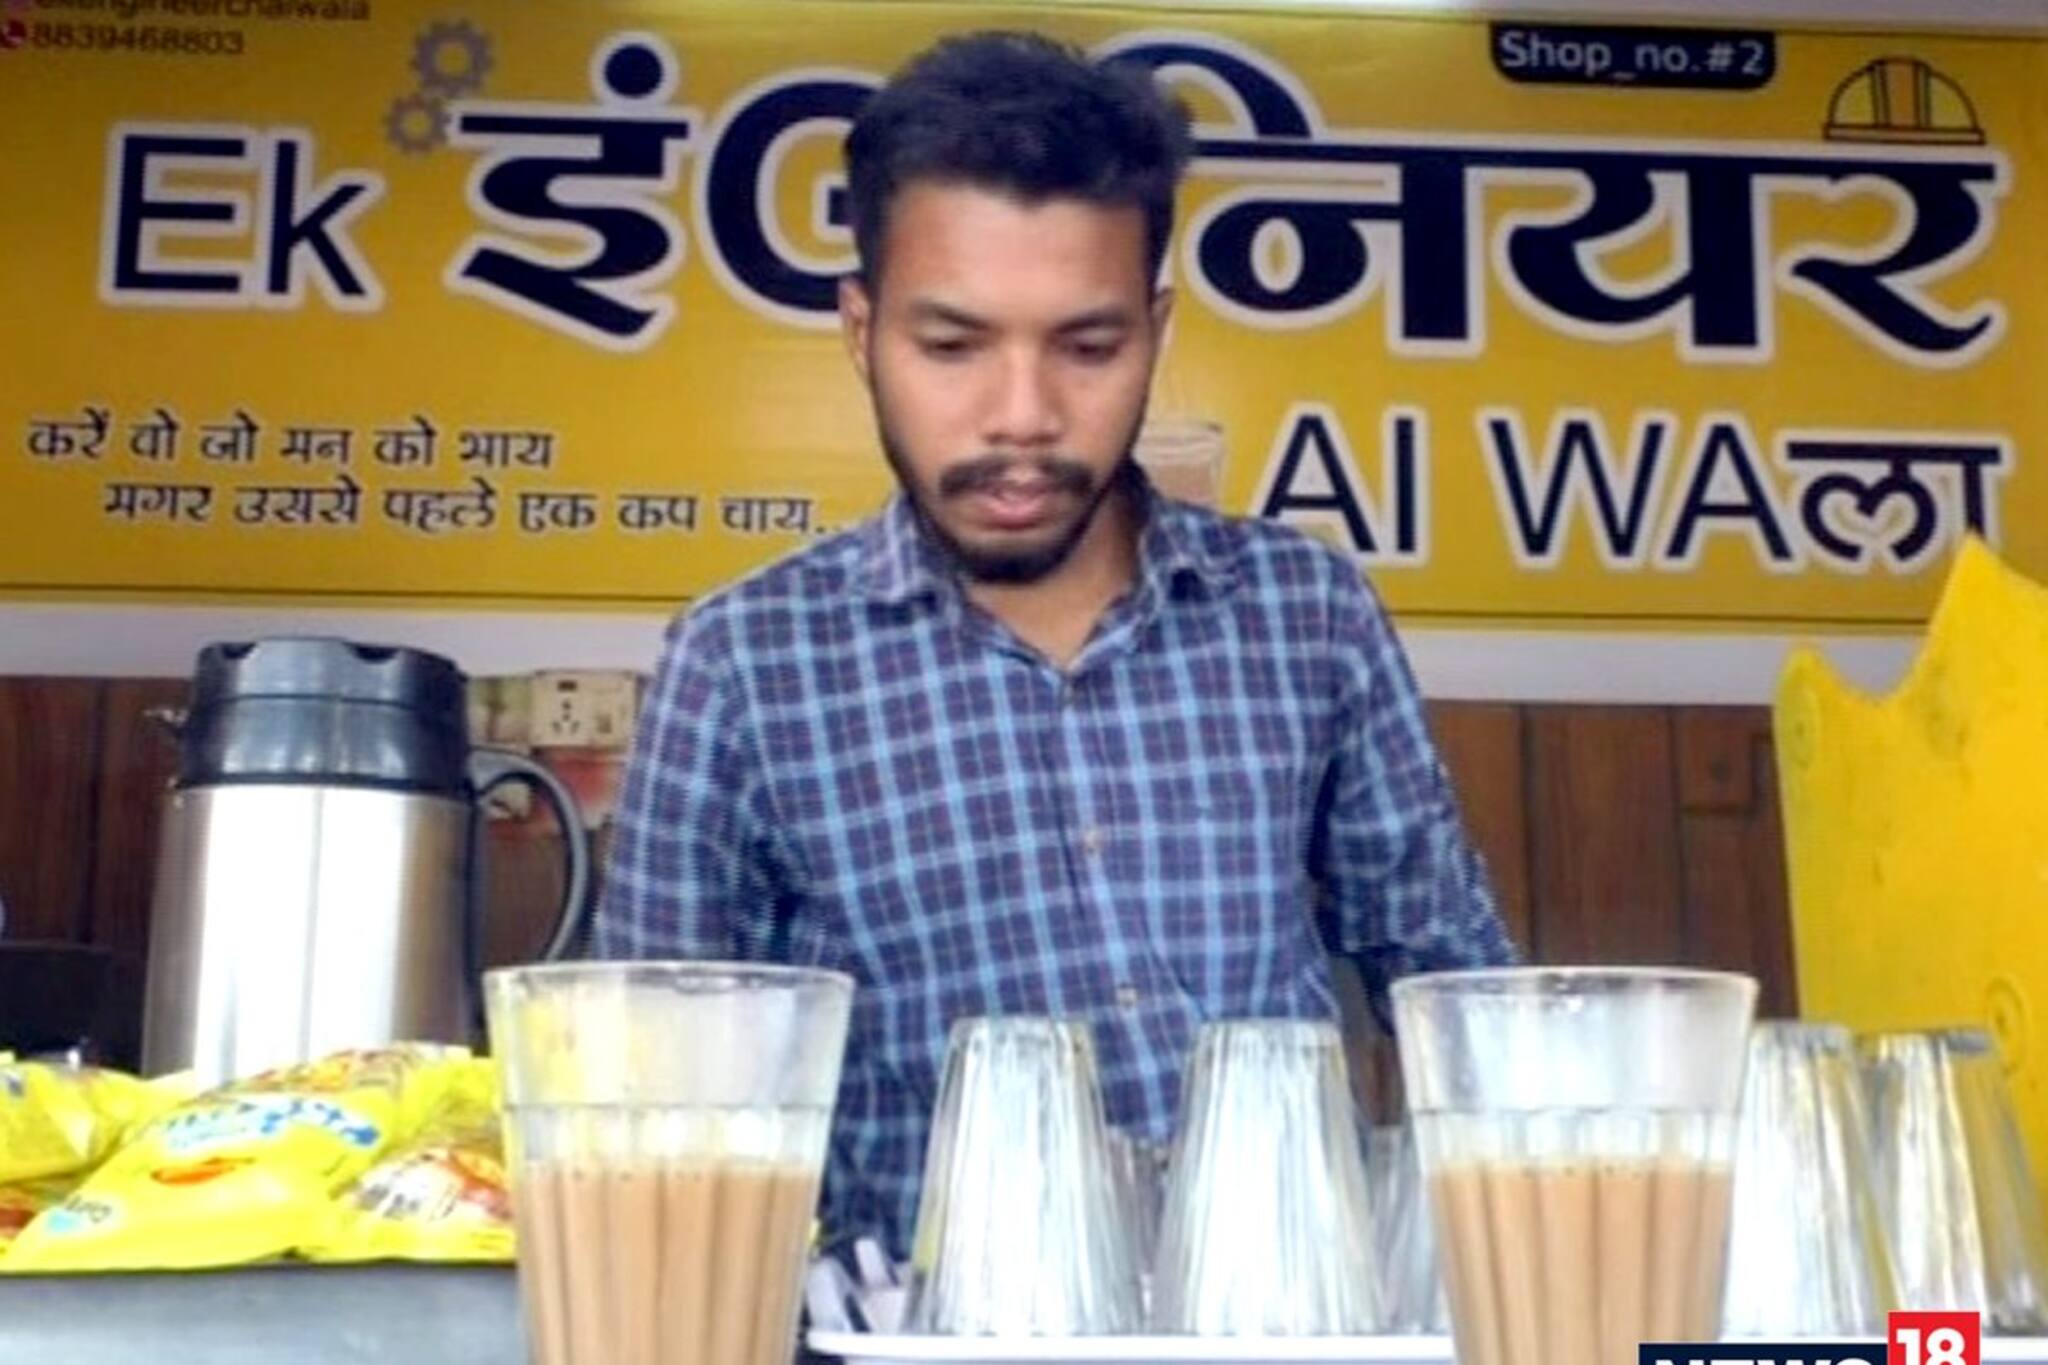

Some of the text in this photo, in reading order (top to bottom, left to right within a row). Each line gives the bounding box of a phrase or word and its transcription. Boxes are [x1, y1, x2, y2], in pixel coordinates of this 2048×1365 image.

[112, 133, 368, 297] Ek
[28, 407, 553, 467] करें वो जो मन को भाय
[104, 482, 212, 520] मगर
[235, 473, 361, 523] उससे
[384, 476, 496, 532] पहले
[519, 491, 597, 532] एक
[618, 493, 697, 530] कप
[1489, 418, 2001, 562] WAला
